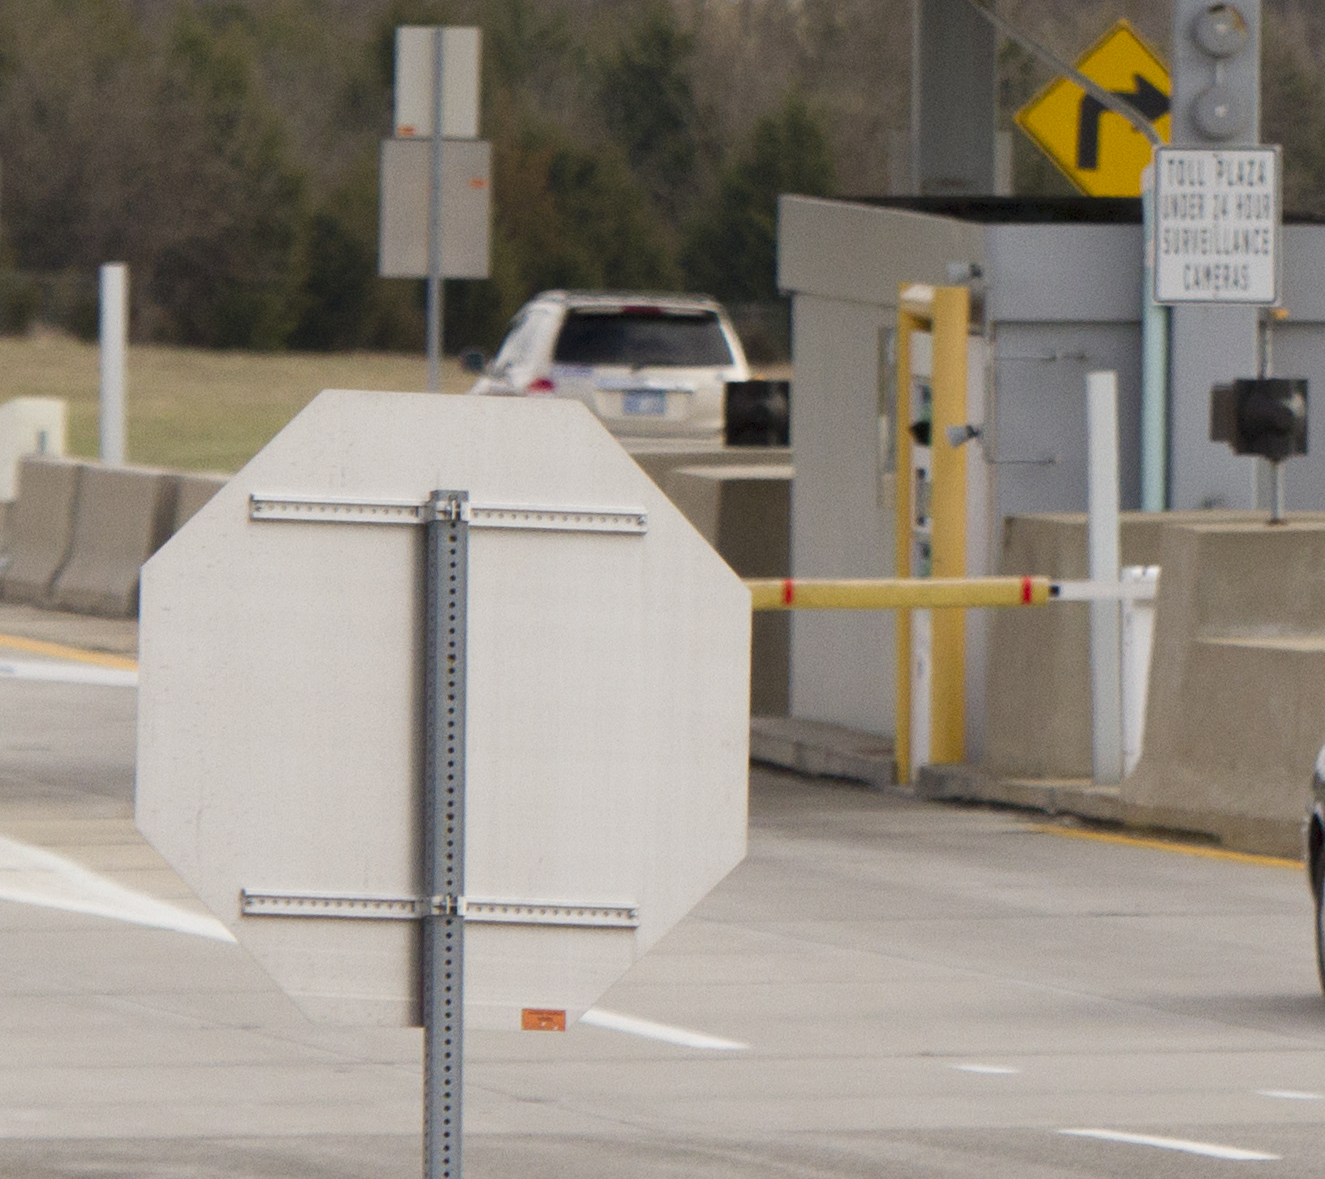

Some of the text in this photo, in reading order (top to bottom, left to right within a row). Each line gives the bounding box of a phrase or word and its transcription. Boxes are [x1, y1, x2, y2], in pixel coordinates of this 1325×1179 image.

[1167, 159, 1266, 187] TOLL PLAZA
[1163, 193, 1271, 220] UNDER 24 HOUR
[1164, 228, 1270, 255] SURVEILLANCE
[1184, 263, 1250, 291] CAMERAS
